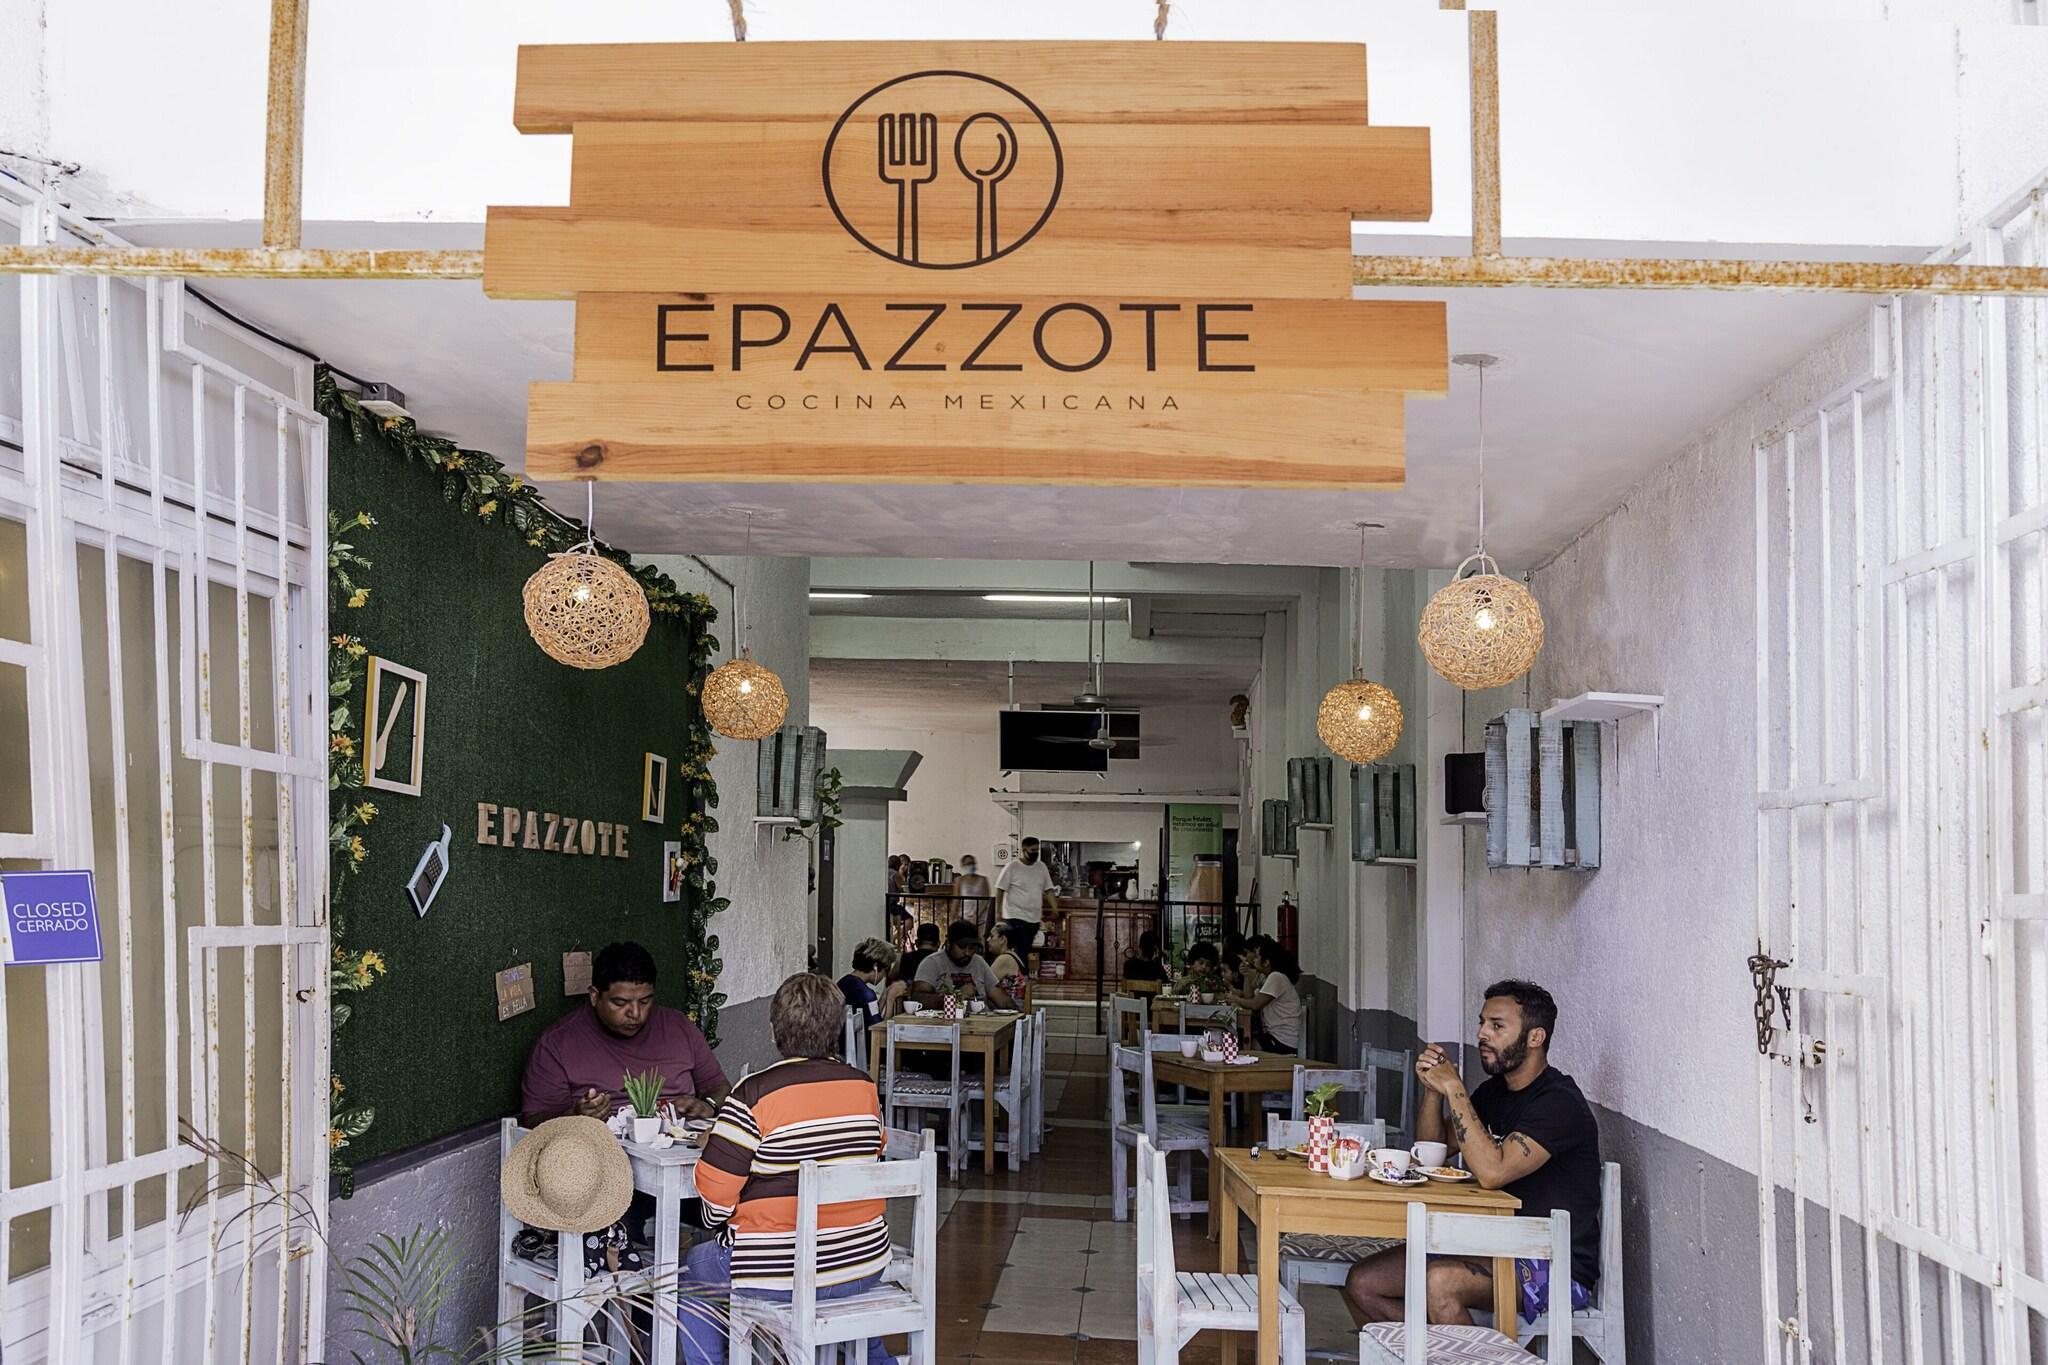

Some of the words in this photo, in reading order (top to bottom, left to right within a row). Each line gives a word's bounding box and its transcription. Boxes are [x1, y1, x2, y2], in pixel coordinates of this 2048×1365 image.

[657, 303, 1256, 372] EPAZZOTE
[736, 394, 907, 410] COCINA
[945, 394, 1180, 411] MEXICANA
[477, 802, 630, 857] EPAZZOTE
[13, 902, 87, 919] CLOSED
[16, 918, 89, 933] CERRADO
